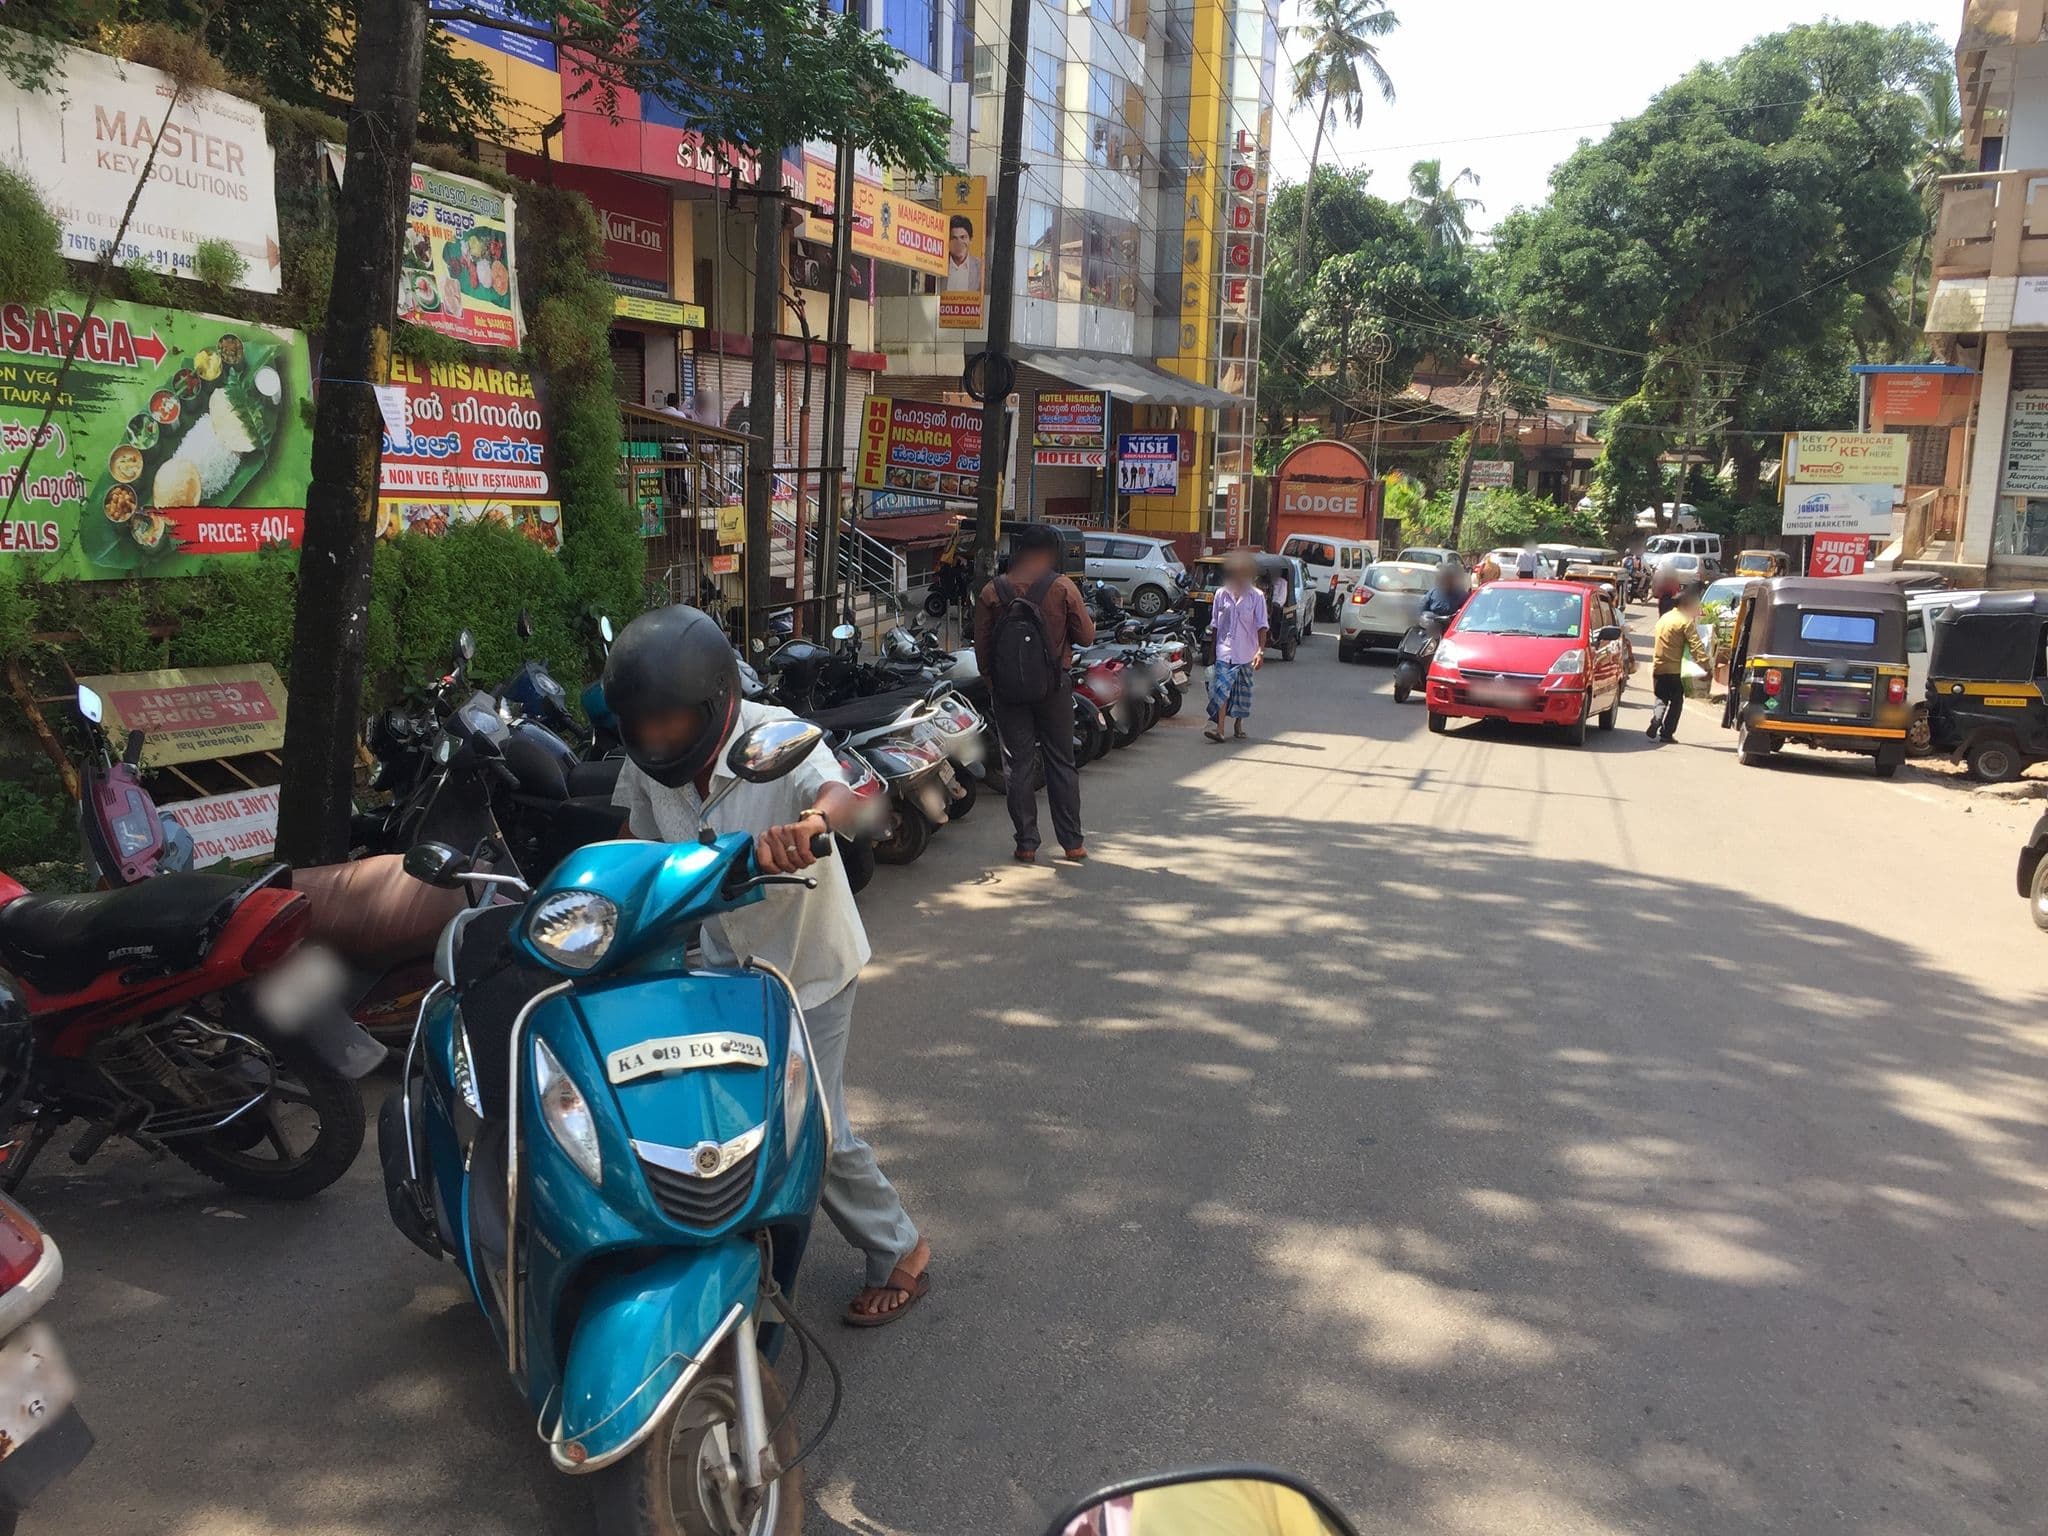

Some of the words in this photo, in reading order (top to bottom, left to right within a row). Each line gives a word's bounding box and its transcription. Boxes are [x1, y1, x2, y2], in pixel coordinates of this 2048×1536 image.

[94, 104, 246, 176] MASTER
[97, 149, 139, 175] KEY
[148, 161, 248, 202] SOLUTIONS
[897, 204, 945, 232] MANAPPURAM
[1227, 129, 1254, 304] LODGE
[110, 217, 177, 240] DPLICATE
[68, 233, 97, 252] 7676
[100, 239, 140, 258] 88766
[150, 250, 168, 265] +91
[898, 231, 922, 250] GOLD
[922, 238, 944, 256] LOAN
[940, 305, 960, 315] GOLD
[961, 306, 980, 315] LOAN
[24, 371, 57, 385] VEG
[391, 353, 422, 384] EL
[430, 361, 535, 399] NISARGA
[1039, 394, 1064, 402] HOTEL
[1065, 394, 1101, 403] NISARGA
[894, 408, 947, 428] ഹോട്ടൽ
[864, 402, 888, 485] HOTEL
[892, 427, 952, 447] NISARGA
[1802, 435, 1823, 443] KEY
[1840, 437, 1894, 445] DUPLICATE
[1128, 441, 1169, 454] NISH
[1802, 444, 1828, 452] LOST
[1839, 446, 1871, 457] KEY
[1037, 452, 1083, 464] HOTEL
[389, 469, 413, 485] NON
[416, 471, 439, 485] VEG
[442, 471, 479, 487] FAMILY
[482, 474, 542, 489] RESTAURANT
[1228, 487, 1237, 537] LODGE
[1284, 494, 1359, 514] LODGE
[1797, 504, 1829, 514] JOHNSON
[199, 521, 248, 543] PRICE:
[1786, 521, 1812, 529] UNIQUE
[1815, 519, 1859, 528] MARKETING
[1816, 540, 1865, 555] JUICE
[141, 687, 242, 709] CEMENT
[129, 706, 217, 726] SUPER
[176, 741, 196, 752] hai
[239, 794, 276, 817] LANE
[225, 828, 275, 852] TRAFFIC
[617, 1056, 644, 1073] KA
[663, 1046, 681, 1061] 19
[689, 1042, 715, 1058] EQ
